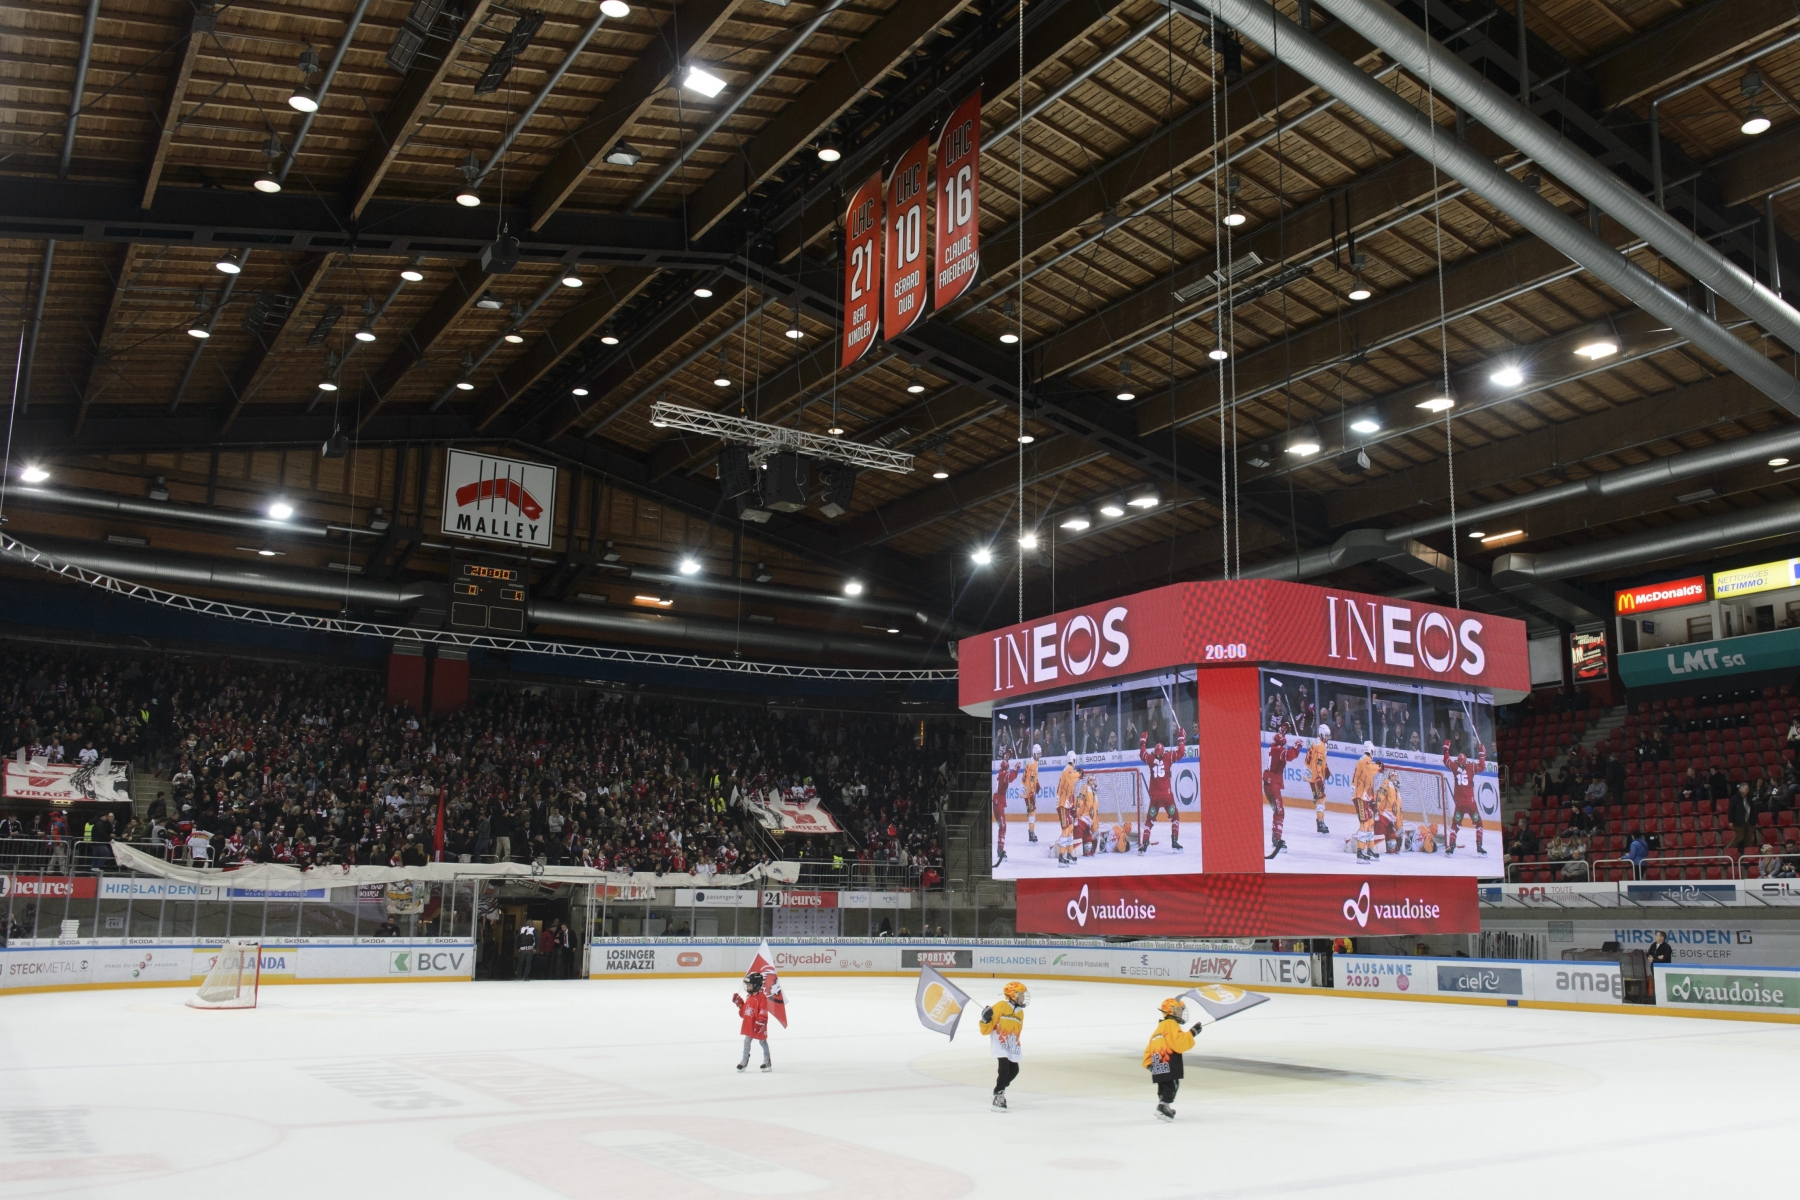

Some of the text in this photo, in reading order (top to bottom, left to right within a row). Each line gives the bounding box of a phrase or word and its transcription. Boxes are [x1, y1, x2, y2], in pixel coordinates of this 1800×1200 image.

[945, 119, 972, 168] LHC
[895, 161, 921, 207] LHC
[945, 164, 972, 236] 16
[852, 197, 874, 240] LHC
[895, 203, 921, 271] 10
[944, 233, 972, 265] CLAUDE
[851, 238, 873, 303] 21
[938, 249, 978, 290] FRIEDERICH
[894, 269, 920, 300] GÉRARD
[898, 298, 914, 316] DUBI
[456, 513, 539, 541] MALLEY
[470, 565, 511, 580] 20:00
[1717, 568, 1769, 584] NETTOYAGES
[1635, 583, 1703, 605] McDonald's
[1717, 578, 1764, 593] NETIMMO
[1326, 596, 1486, 676] INEOS
[993, 606, 1130, 692] INEOS
[1205, 643, 1247, 660] 20:00
[1667, 648, 1719, 675] LMT
[1283, 767, 1350, 788] IRSDEN
[13, 789, 73, 798] VIRAGE
[1006, 786, 1056, 799] IRSDEN
[13, 881, 74, 895] heures
[105, 884, 197, 895] HIRSLANDEN
[1518, 886, 1551, 903] PCL
[764, 892, 822, 907] 24 heures
[1090, 898, 1156, 920] vaudoise
[1373, 898, 1440, 920] vaudoise
[1614, 929, 1731, 944] HIRSANDEN
[417, 952, 465, 971] BCV
[606, 950, 655, 960] LOSINGER
[775, 953, 832, 965] Citycable
[979, 956, 1037, 965] HIRSLANDEN
[1680, 949, 1732, 958] BOIS-CERF
[9, 961, 78, 975] STECKMETAL
[222, 957, 286, 969] CALANDA
[606, 960, 655, 970] MARAZZI
[1120, 966, 1170, 977] E-GESTION
[1189, 957, 1238, 980] HENRY
[1259, 958, 1310, 984] INEO
[1346, 962, 1413, 976] LAUSANNE
[1346, 974, 1380, 988] 2020
[1458, 971, 1482, 989] ciel
[1693, 981, 1784, 1004] vaudoise
